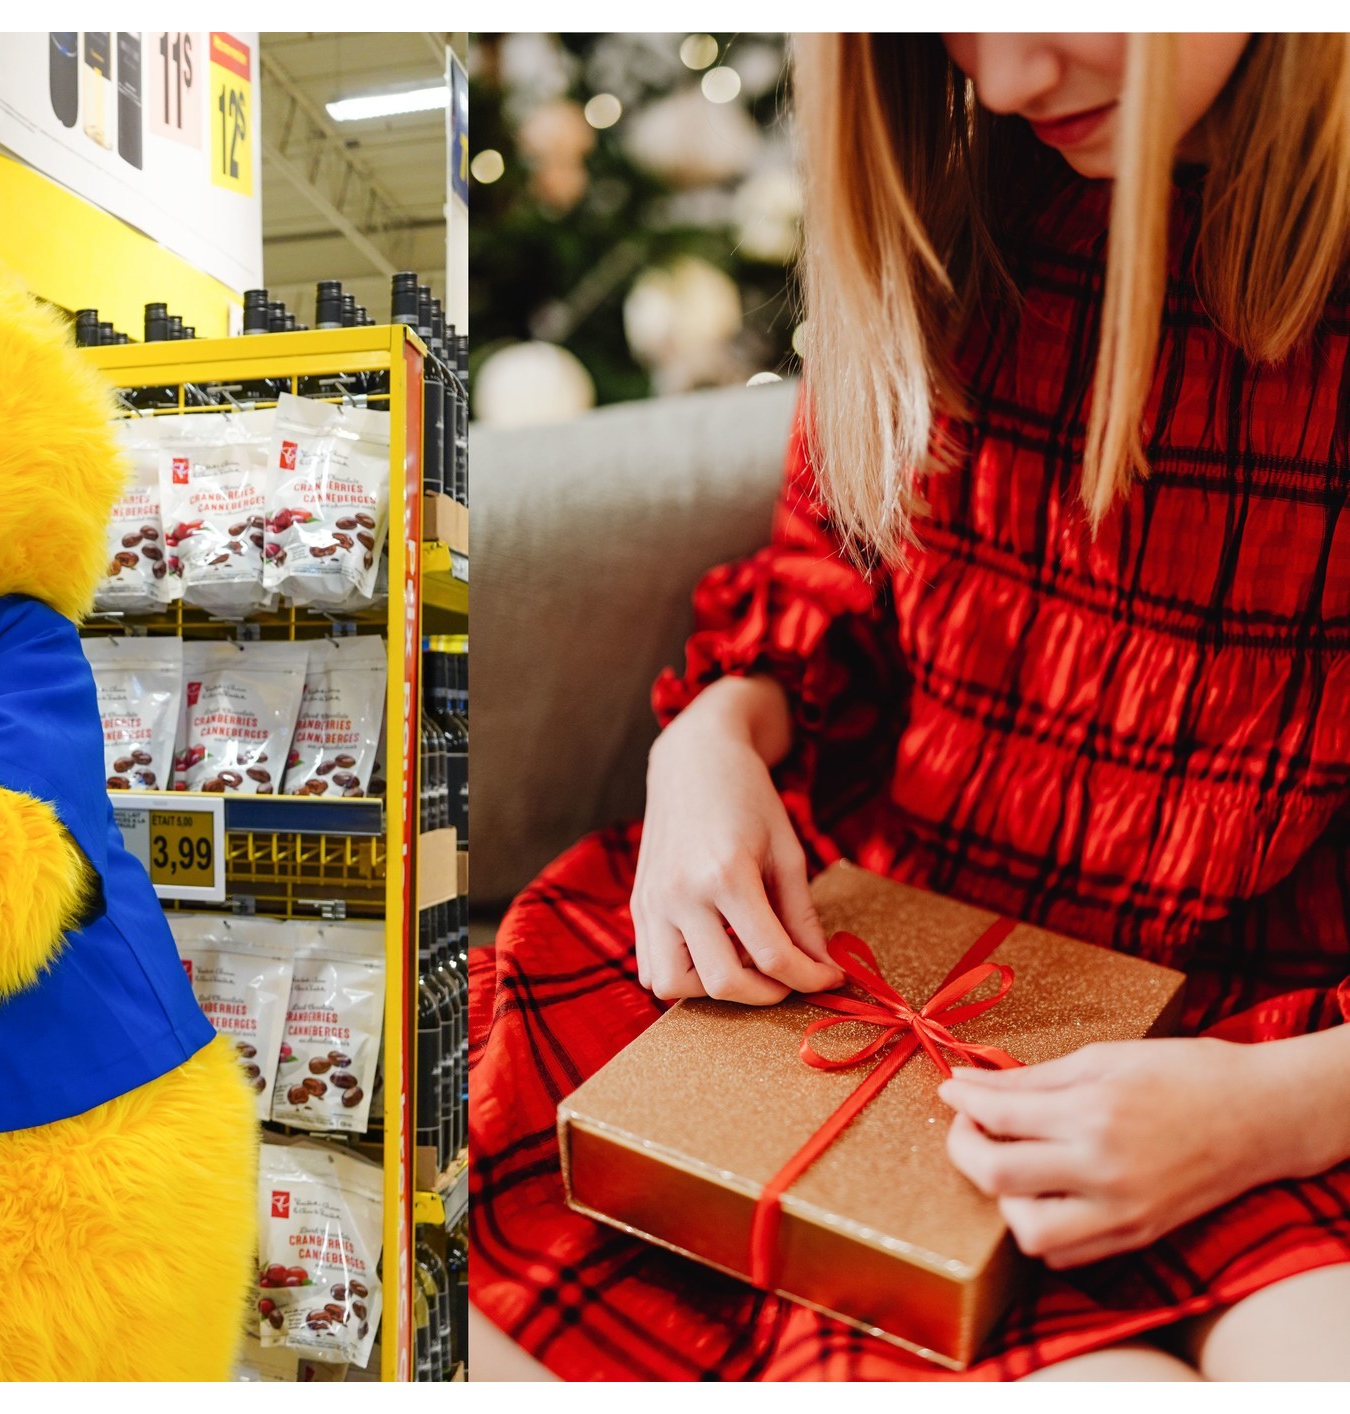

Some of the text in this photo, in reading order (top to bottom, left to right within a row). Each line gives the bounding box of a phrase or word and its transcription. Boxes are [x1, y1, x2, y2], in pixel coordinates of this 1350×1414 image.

[293, 480, 363, 493] CRANERRIES
[194, 714, 258, 727] CRANBERRIES
[201, 726, 269, 739] CANNEBERGES
[153, 835, 212, 875] 3,99
[286, 1011, 339, 1023] RANBERRIES
[289, 1234, 355, 1254] CRANBRRIES
